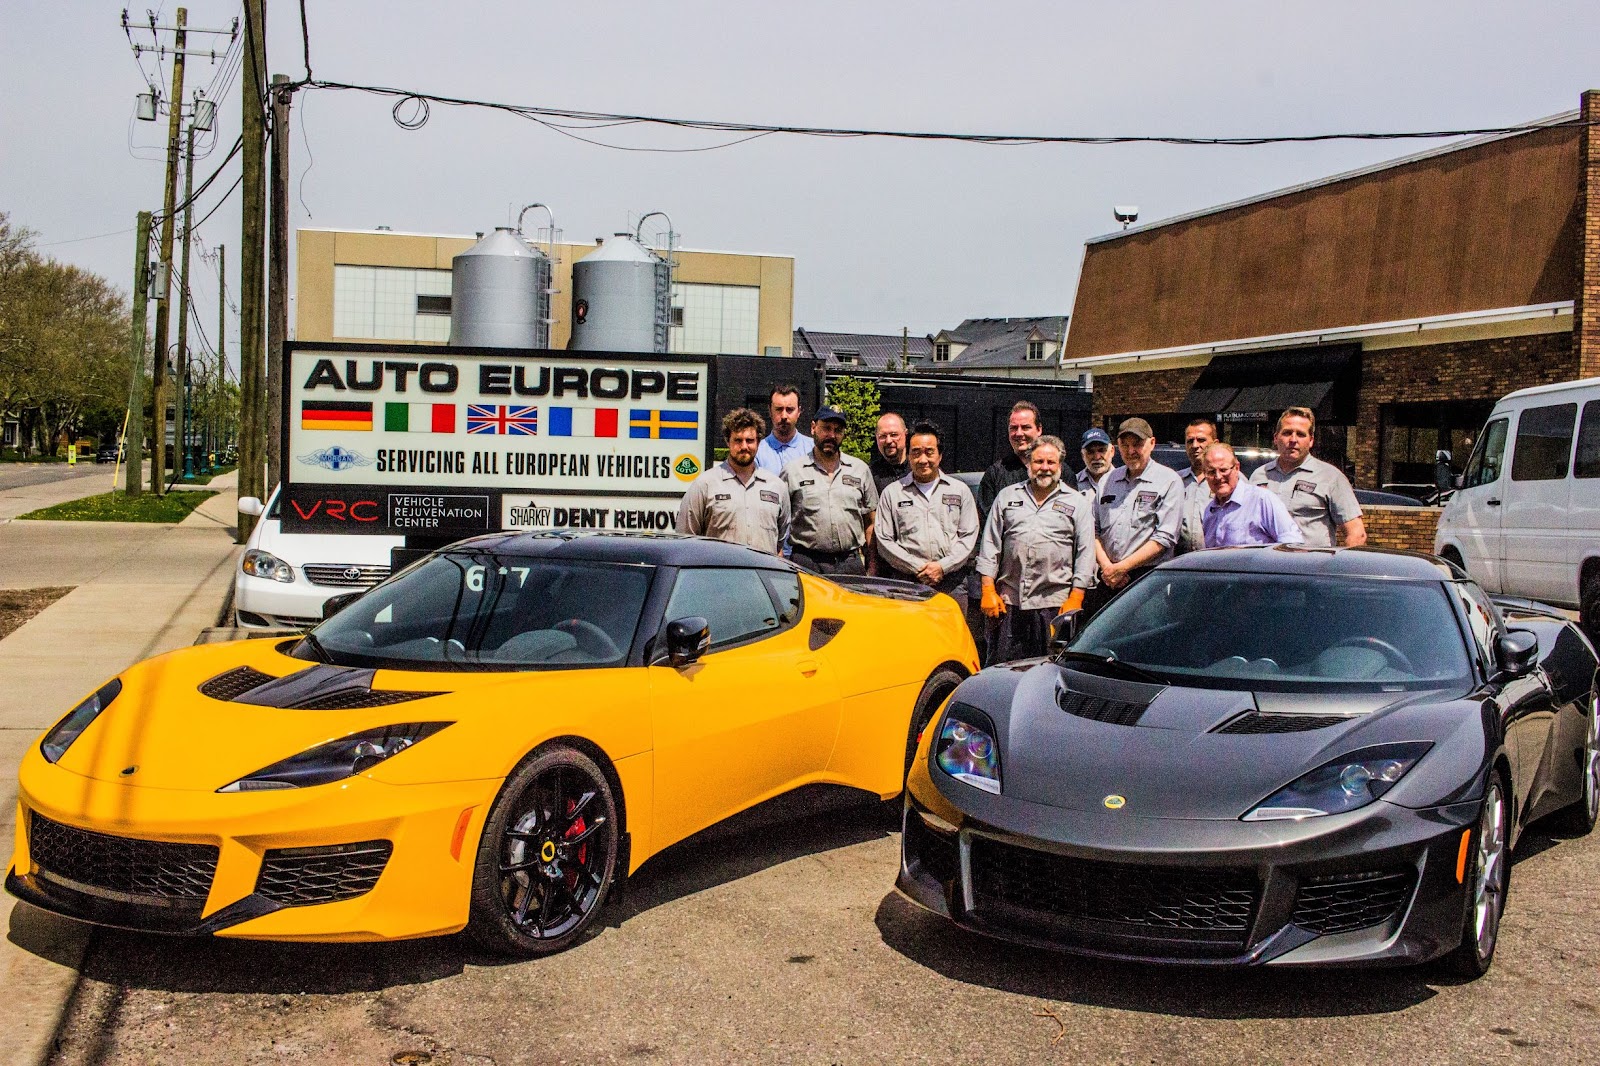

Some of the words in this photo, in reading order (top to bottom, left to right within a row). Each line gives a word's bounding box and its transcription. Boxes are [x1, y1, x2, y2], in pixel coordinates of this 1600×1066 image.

[303, 359, 460, 393] AUTO
[479, 364, 699, 400] EUROPE
[320, 454, 353, 463] MORGAN
[376, 449, 465, 474] SERVICING
[472, 451, 499, 475] ALL
[506, 452, 590, 477] EUROPEAN
[597, 454, 671, 479] VEHICLES
[676, 464, 699, 474] LOTUS
[394, 497, 444, 507] VEHICLE
[291, 499, 379, 521] VRC
[394, 507, 482, 518] REJUVENATION
[394, 518, 439, 528] CENTER
[510, 507, 551, 526] SHARKEY
[553, 507, 609, 528] DENT
